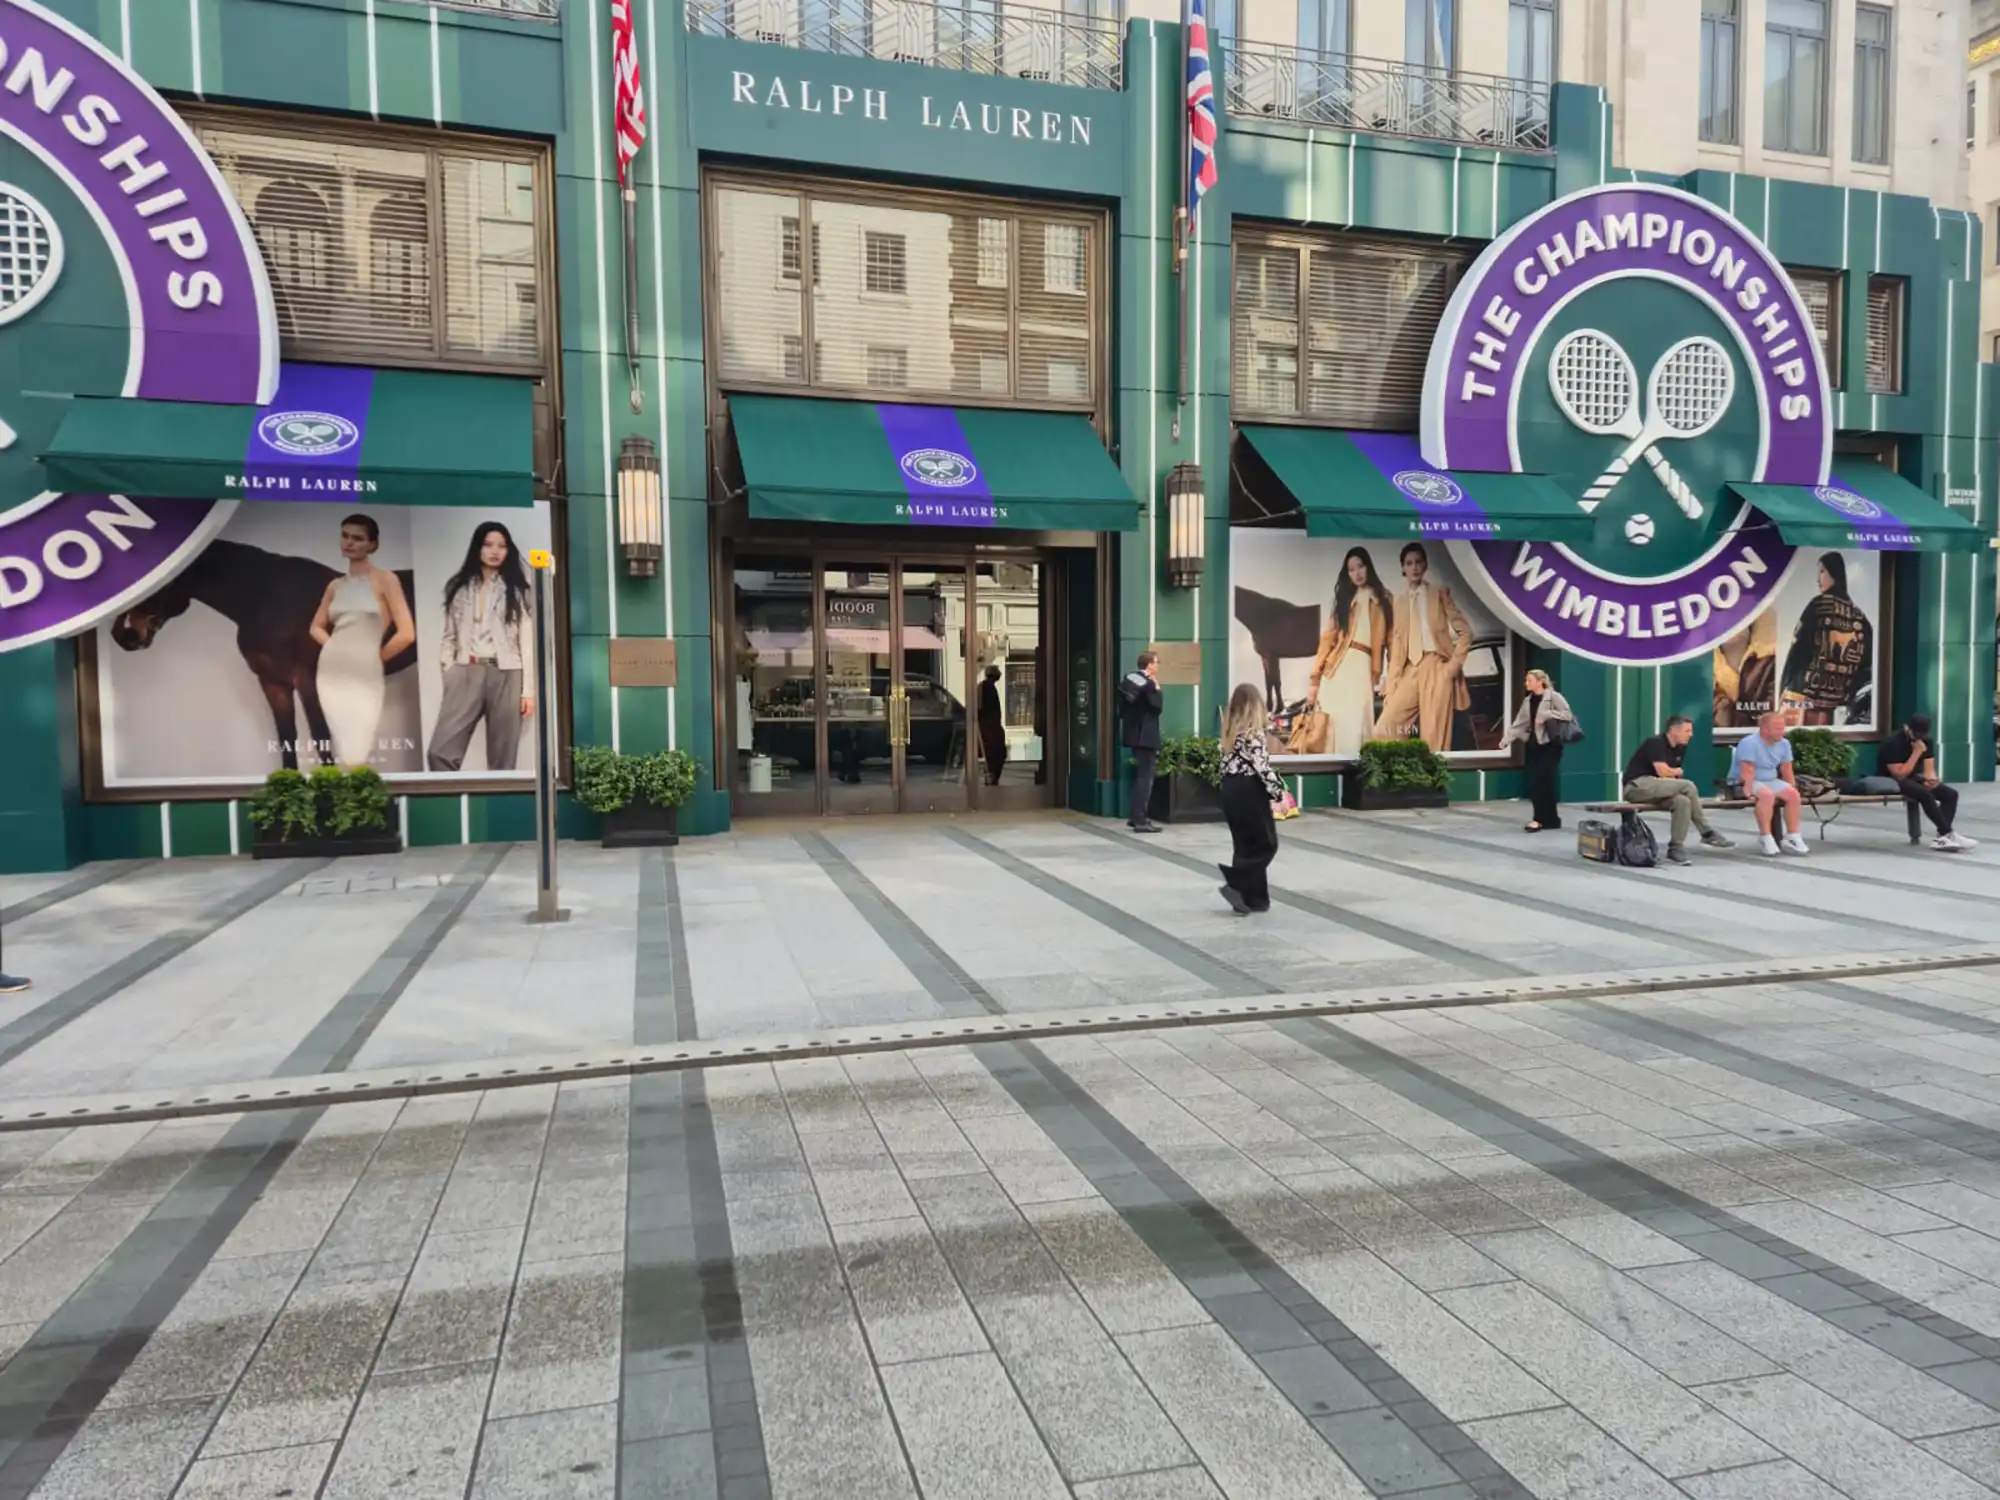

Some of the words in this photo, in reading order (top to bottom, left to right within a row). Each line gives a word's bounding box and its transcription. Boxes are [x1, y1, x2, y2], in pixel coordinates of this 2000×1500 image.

[731, 70, 889, 121] RALPH
[921, 95, 1093, 146] LAUREN
[0, 36, 223, 309] NSHIPS
[1461, 295, 1522, 401] THE
[1513, 211, 1812, 422] CHAMPIONSHIPS
[224, 474, 291, 489] RALPH
[301, 477, 378, 492] LAUREN
[895, 504, 944, 516] RALPH
[951, 506, 1009, 518] LAUREN
[1409, 521, 1450, 531] RALPH
[1455, 522, 1501, 532] LAUREN
[1510, 540, 1769, 639] WIMBLEDON
[1735, 701, 1770, 711] RALPH
[267, 739, 332, 753] RALPH
